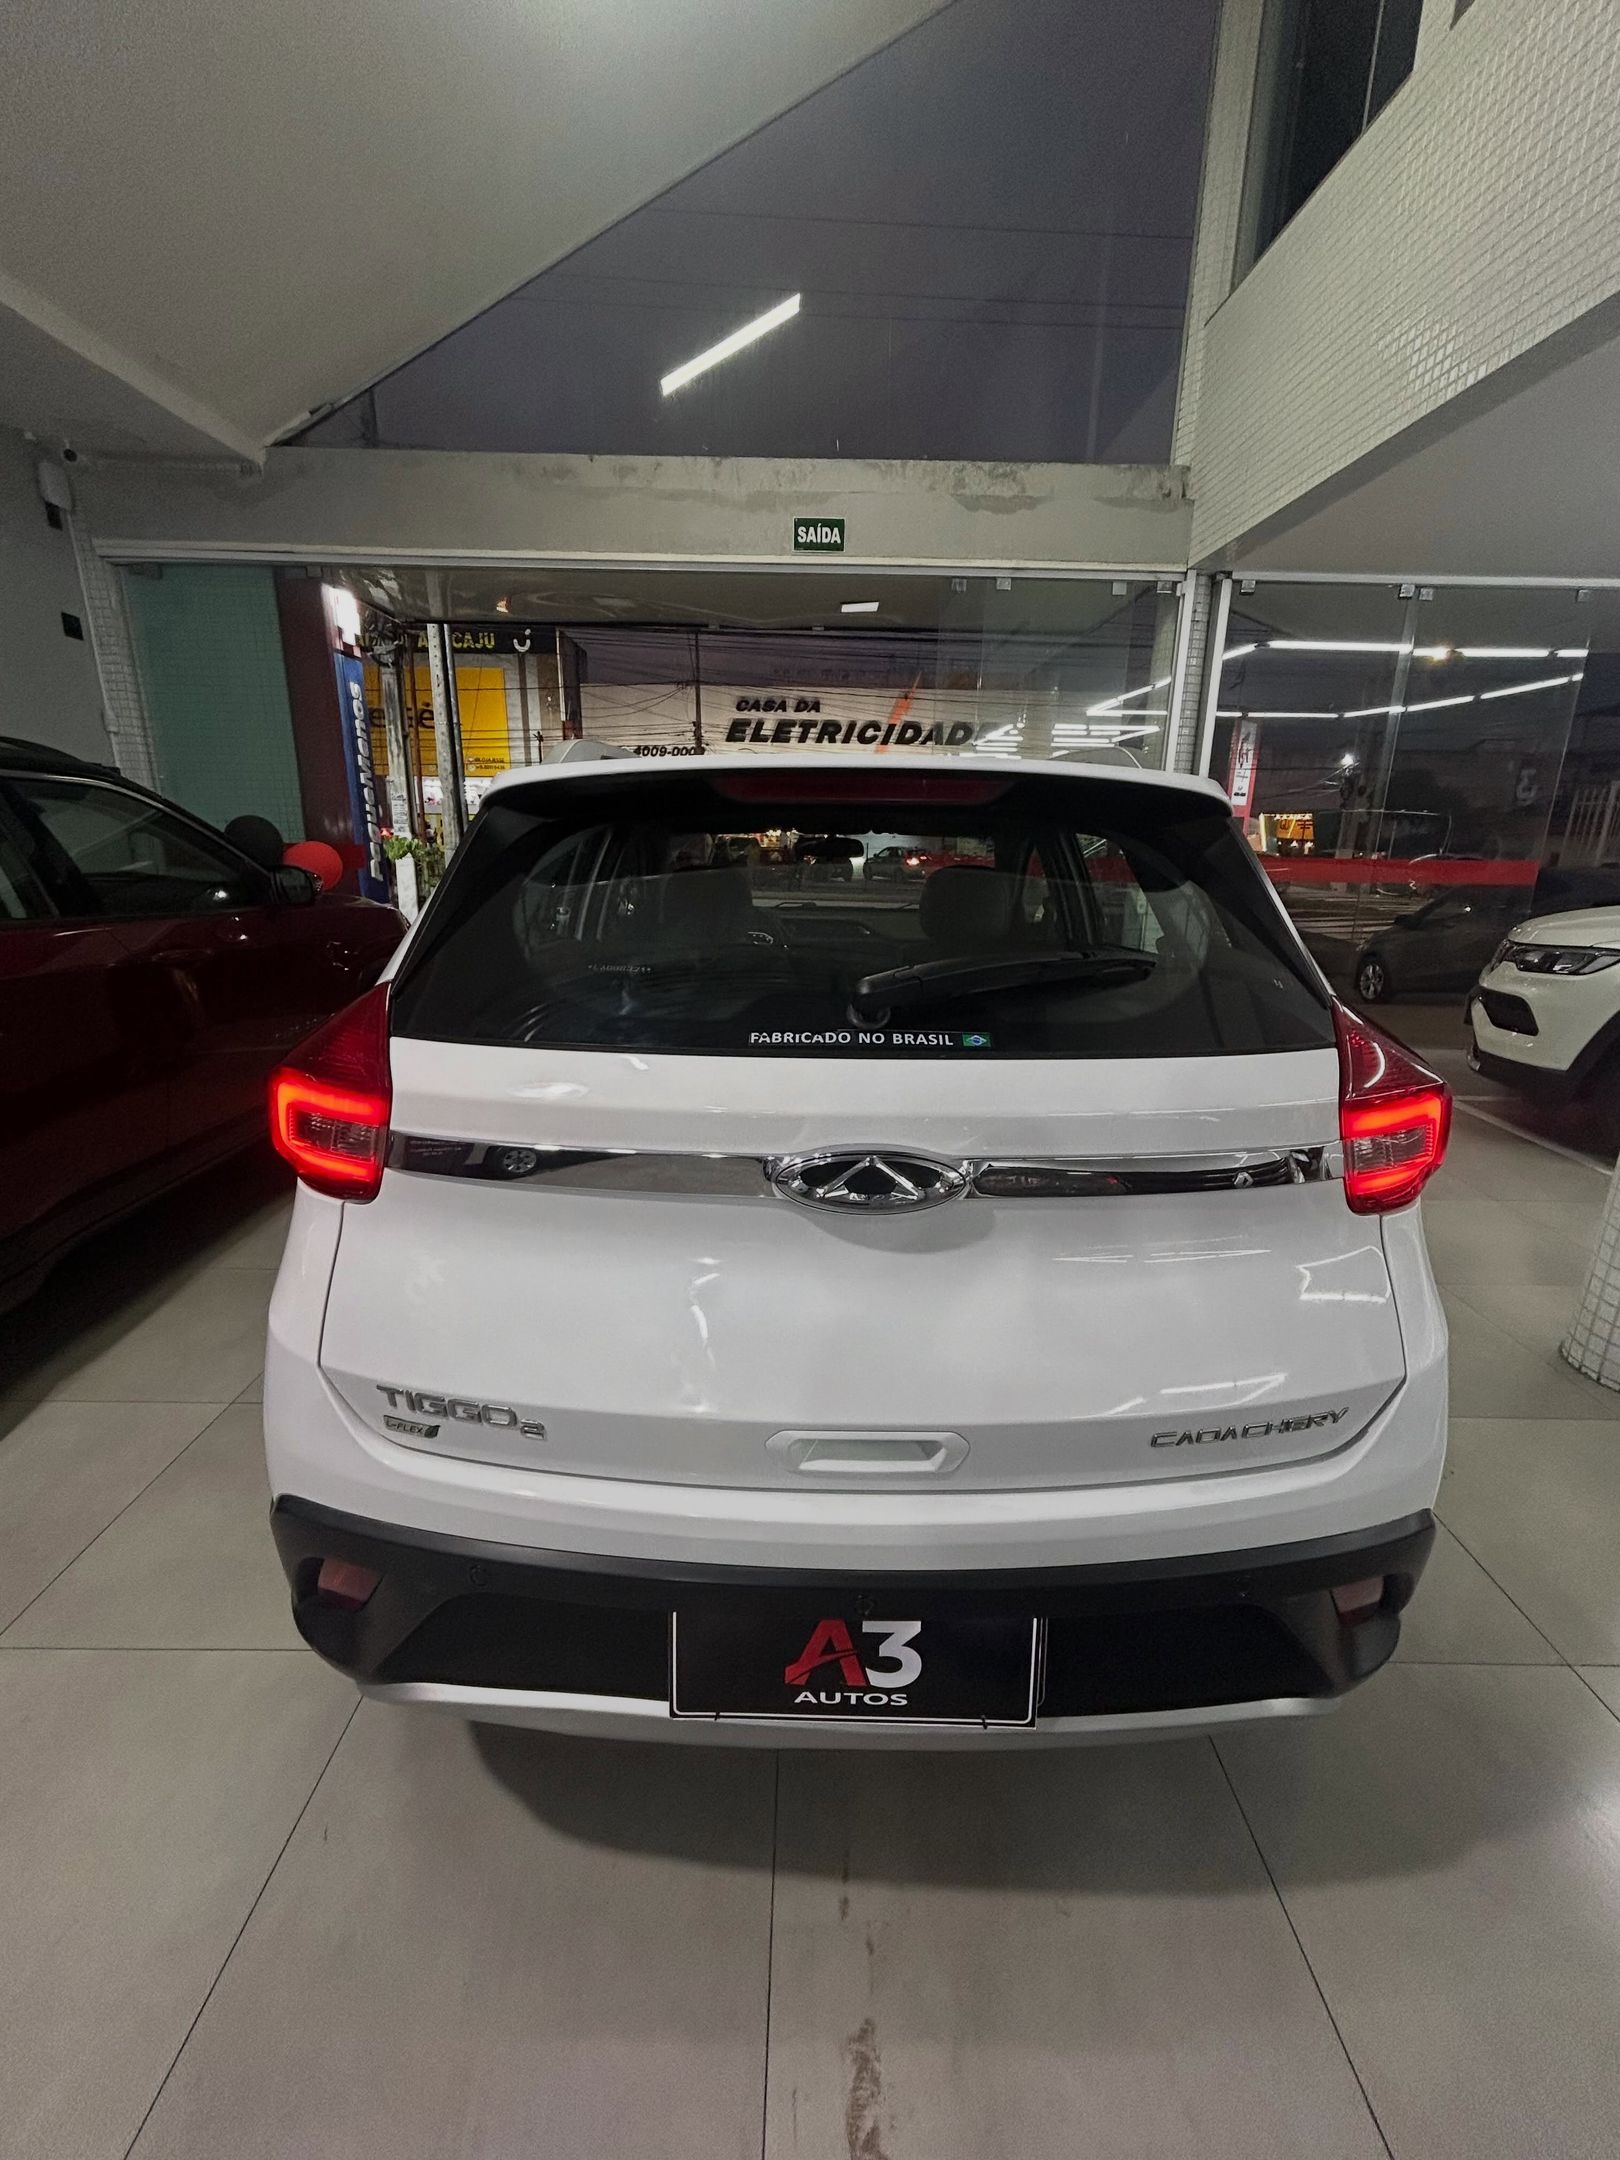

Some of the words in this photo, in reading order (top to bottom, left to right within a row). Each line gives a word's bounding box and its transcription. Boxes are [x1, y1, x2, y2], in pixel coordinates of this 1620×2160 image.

[797, 523, 841, 544] SAÍDA
[736, 698, 787, 713] CASA
[794, 698, 821, 713] DA
[350, 681, 384, 882] PagueMenos
[750, 1032, 851, 1044] FABRICADO
[858, 1032, 885, 1044] NO
[892, 1033, 954, 1046] BRASIL
[785, 1618, 923, 1689] A3
[794, 1691, 908, 1706] AUTOS
